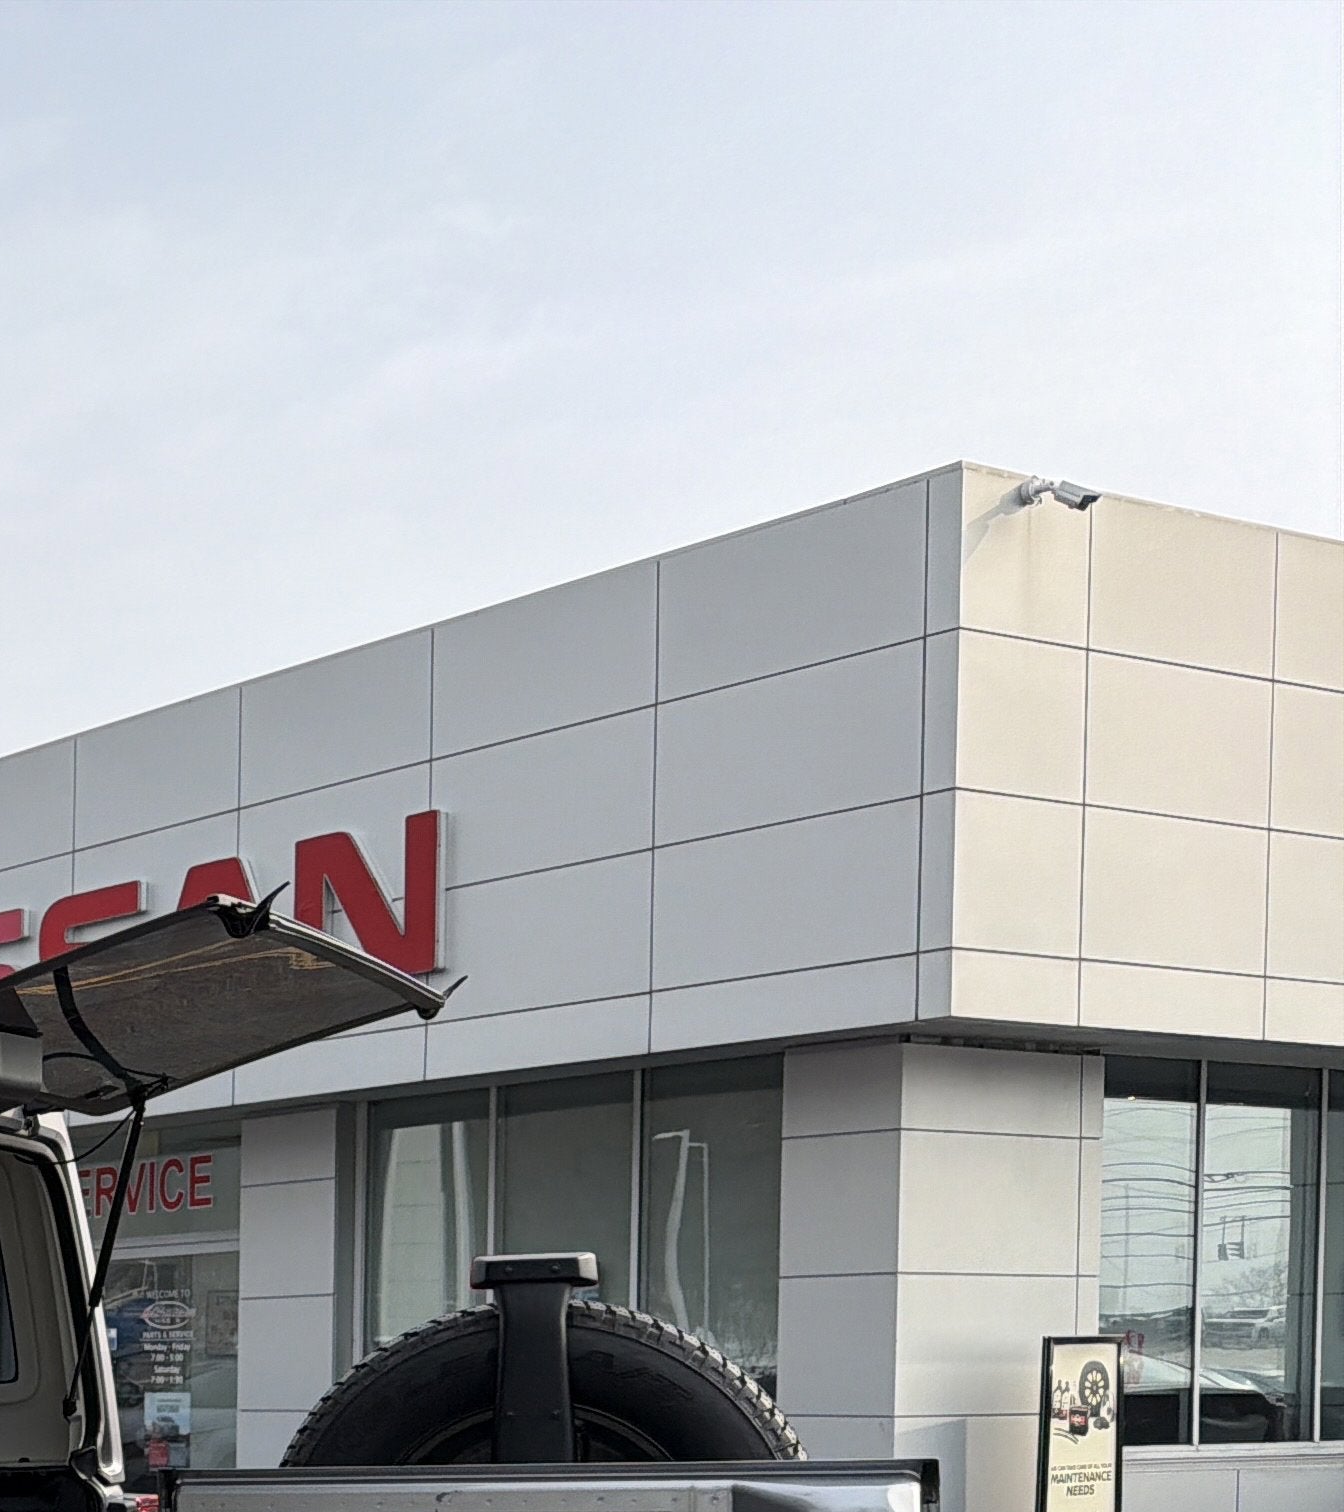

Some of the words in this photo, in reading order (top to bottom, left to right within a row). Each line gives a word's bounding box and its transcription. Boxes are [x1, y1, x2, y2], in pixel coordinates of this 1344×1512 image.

[146, 1289, 179, 1299] WELCOME
[180, 1288, 191, 1298] TO
[142, 1331, 161, 1339] PARTS
[168, 1330, 193, 1338] SERVICE
[143, 1343, 167, 1352] Monday
[172, 1343, 191, 1352] Friday
[153, 1365, 181, 1374] Saturday
[1050, 1470, 1112, 1484] MAINTENANCE
[1066, 1484, 1095, 1496] NEEDS
